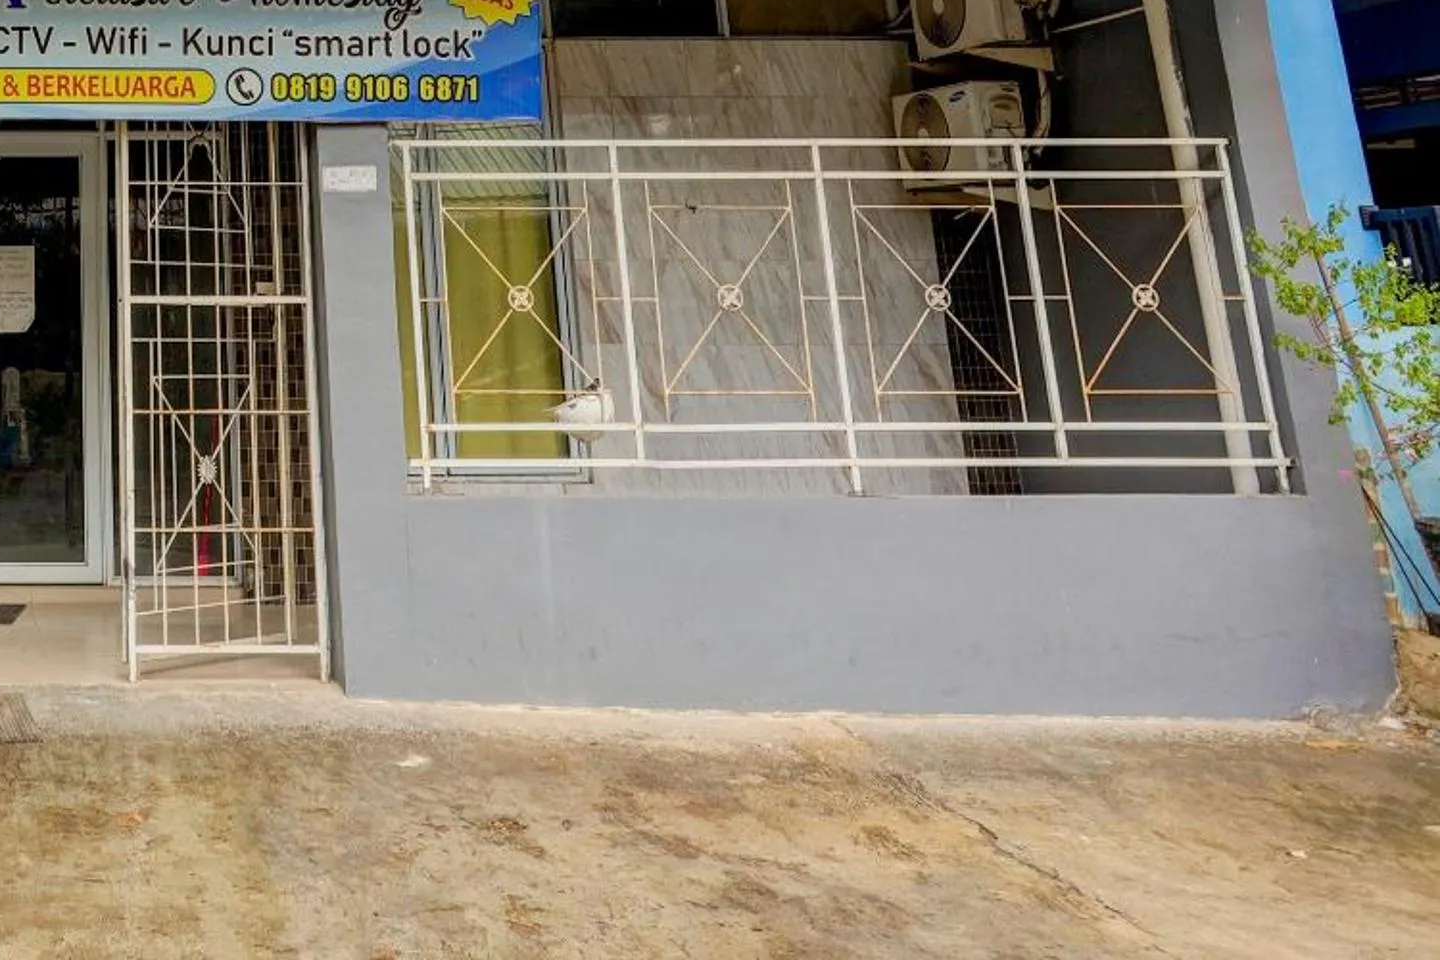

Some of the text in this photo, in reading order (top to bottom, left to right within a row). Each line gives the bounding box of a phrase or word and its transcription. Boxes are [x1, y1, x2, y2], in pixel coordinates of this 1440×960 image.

[85, 27, 148, 55] Wifi
[182, 28, 275, 56] Kunci
[4, 75, 20, 97] &
[27, 75, 196, 98] BERKELUARGA
[271, 73, 480, 102] 0819 9106 6871
